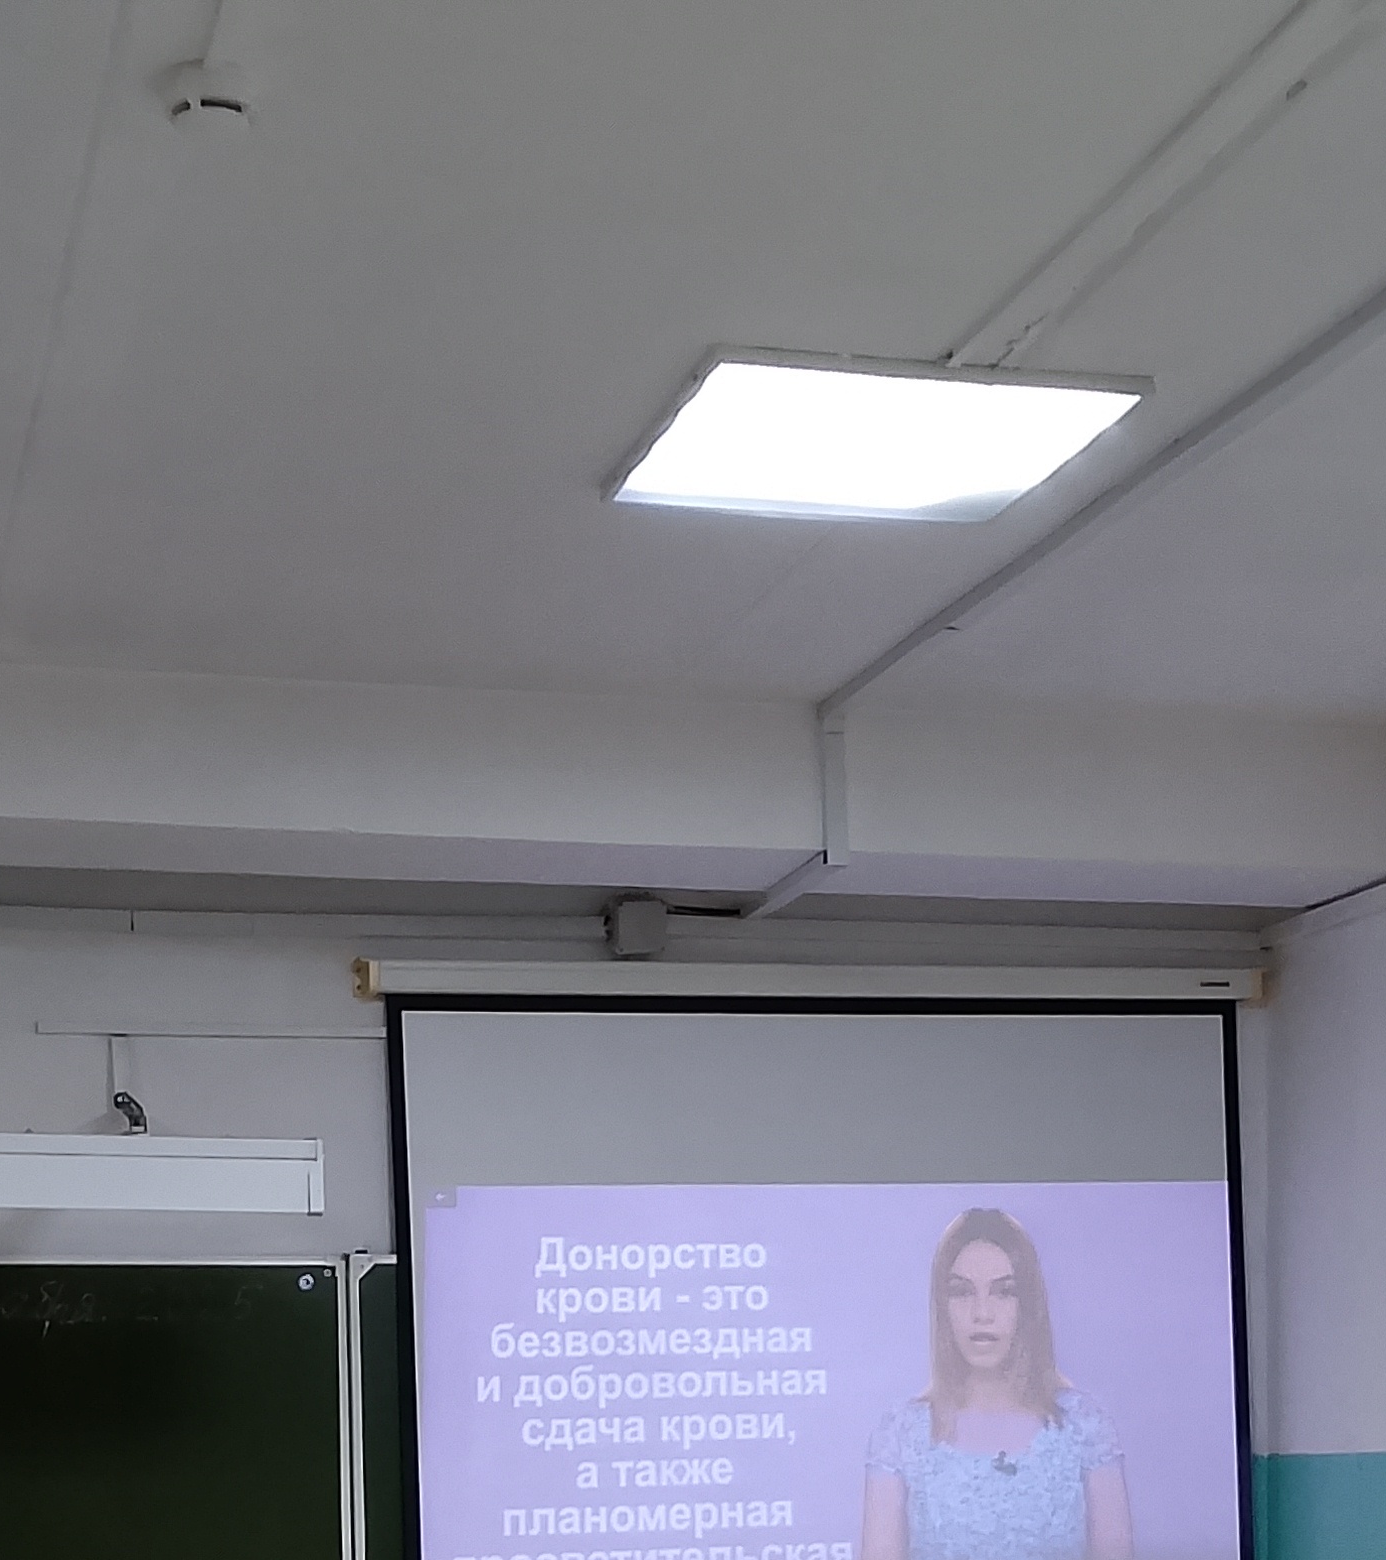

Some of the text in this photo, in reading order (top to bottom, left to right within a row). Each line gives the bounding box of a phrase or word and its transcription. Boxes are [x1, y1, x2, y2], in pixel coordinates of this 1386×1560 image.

[534, 1237, 767, 1277] Донорство
[536, 1287, 662, 1321] крови
[702, 1283, 769, 1312] это
[490, 1322, 813, 1360] безвозмездная
[477, 1366, 828, 1409] и добровольная
[521, 1411, 797, 1450] сдача крови,
[576, 1454, 734, 1489] а также
[502, 1500, 793, 1538] планомерная
